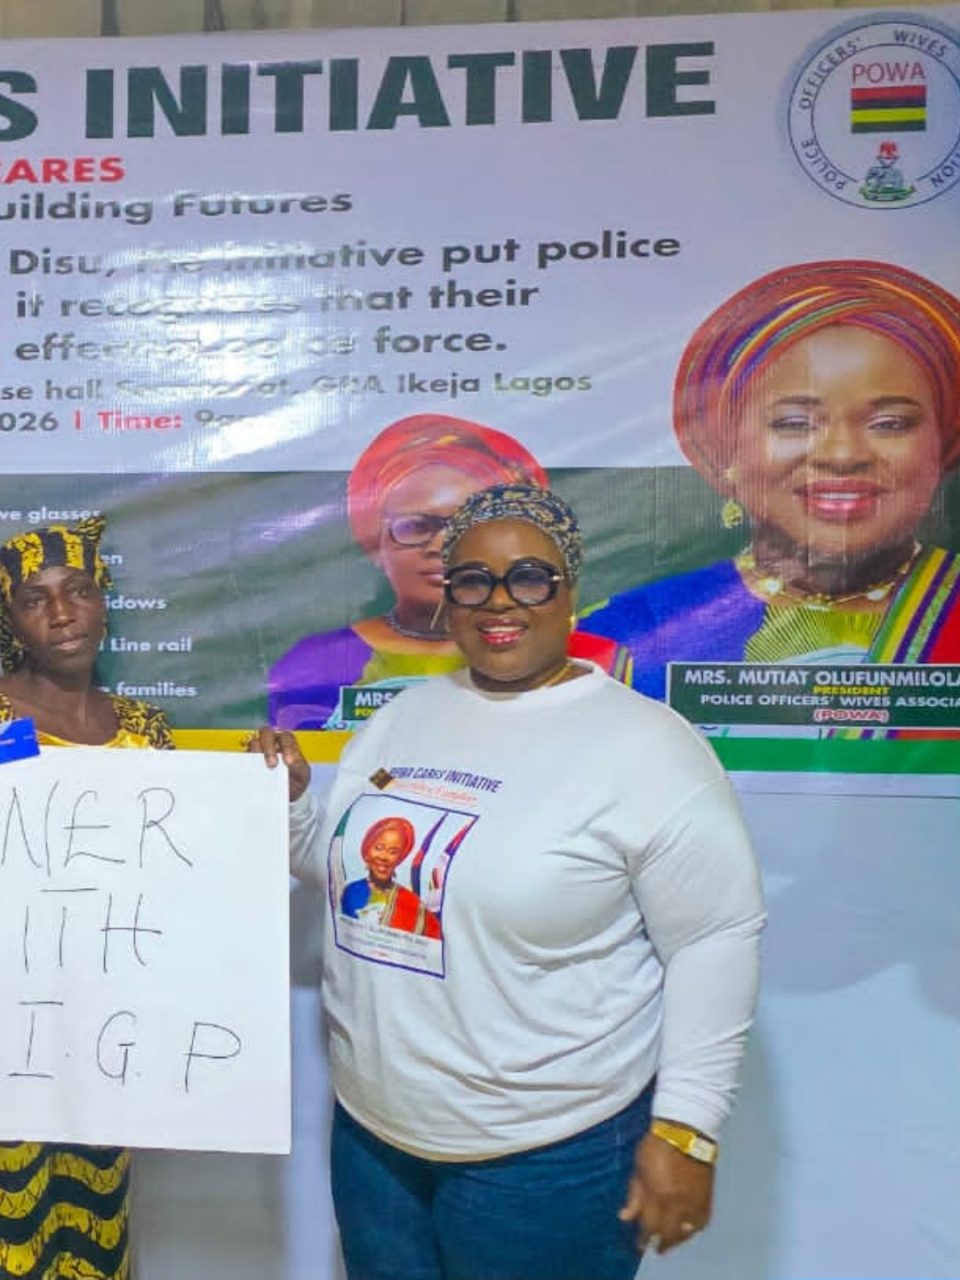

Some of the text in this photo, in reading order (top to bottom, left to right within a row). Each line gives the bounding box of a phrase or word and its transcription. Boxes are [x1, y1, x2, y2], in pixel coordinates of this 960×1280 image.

[893, 29, 950, 58] WIVES
[851, 62, 927, 84] POWA
[84, 41, 716, 140] INITIATIVE
[802, 138, 847, 190] POLICE
[172, 189, 353, 216] Futures
[10, 249, 117, 279] Disu,
[442, 238, 520, 272] put
[539, 230, 681, 269] police
[430, 279, 540, 308] their
[375, 325, 507, 354] force.
[45, 379, 103, 400] hall
[397, 371, 481, 399] Ikeja
[493, 371, 593, 397] Lagos
[97, 408, 183, 431] Time:
[105, 595, 168, 610] idows
[111, 637, 152, 652] Line
[158, 637, 193, 652] rail
[117, 680, 198, 697] families
[684, 670, 731, 686] MRS.
[738, 669, 809, 686] MUTIAT
[700, 694, 960, 708] POLICE OFFICERS' WIVES ASSOCIA
[812, 685, 890, 695] PRESIDENT
[813, 708, 889, 723] (POWA)
[444, 769, 505, 793] INITIATIVE
